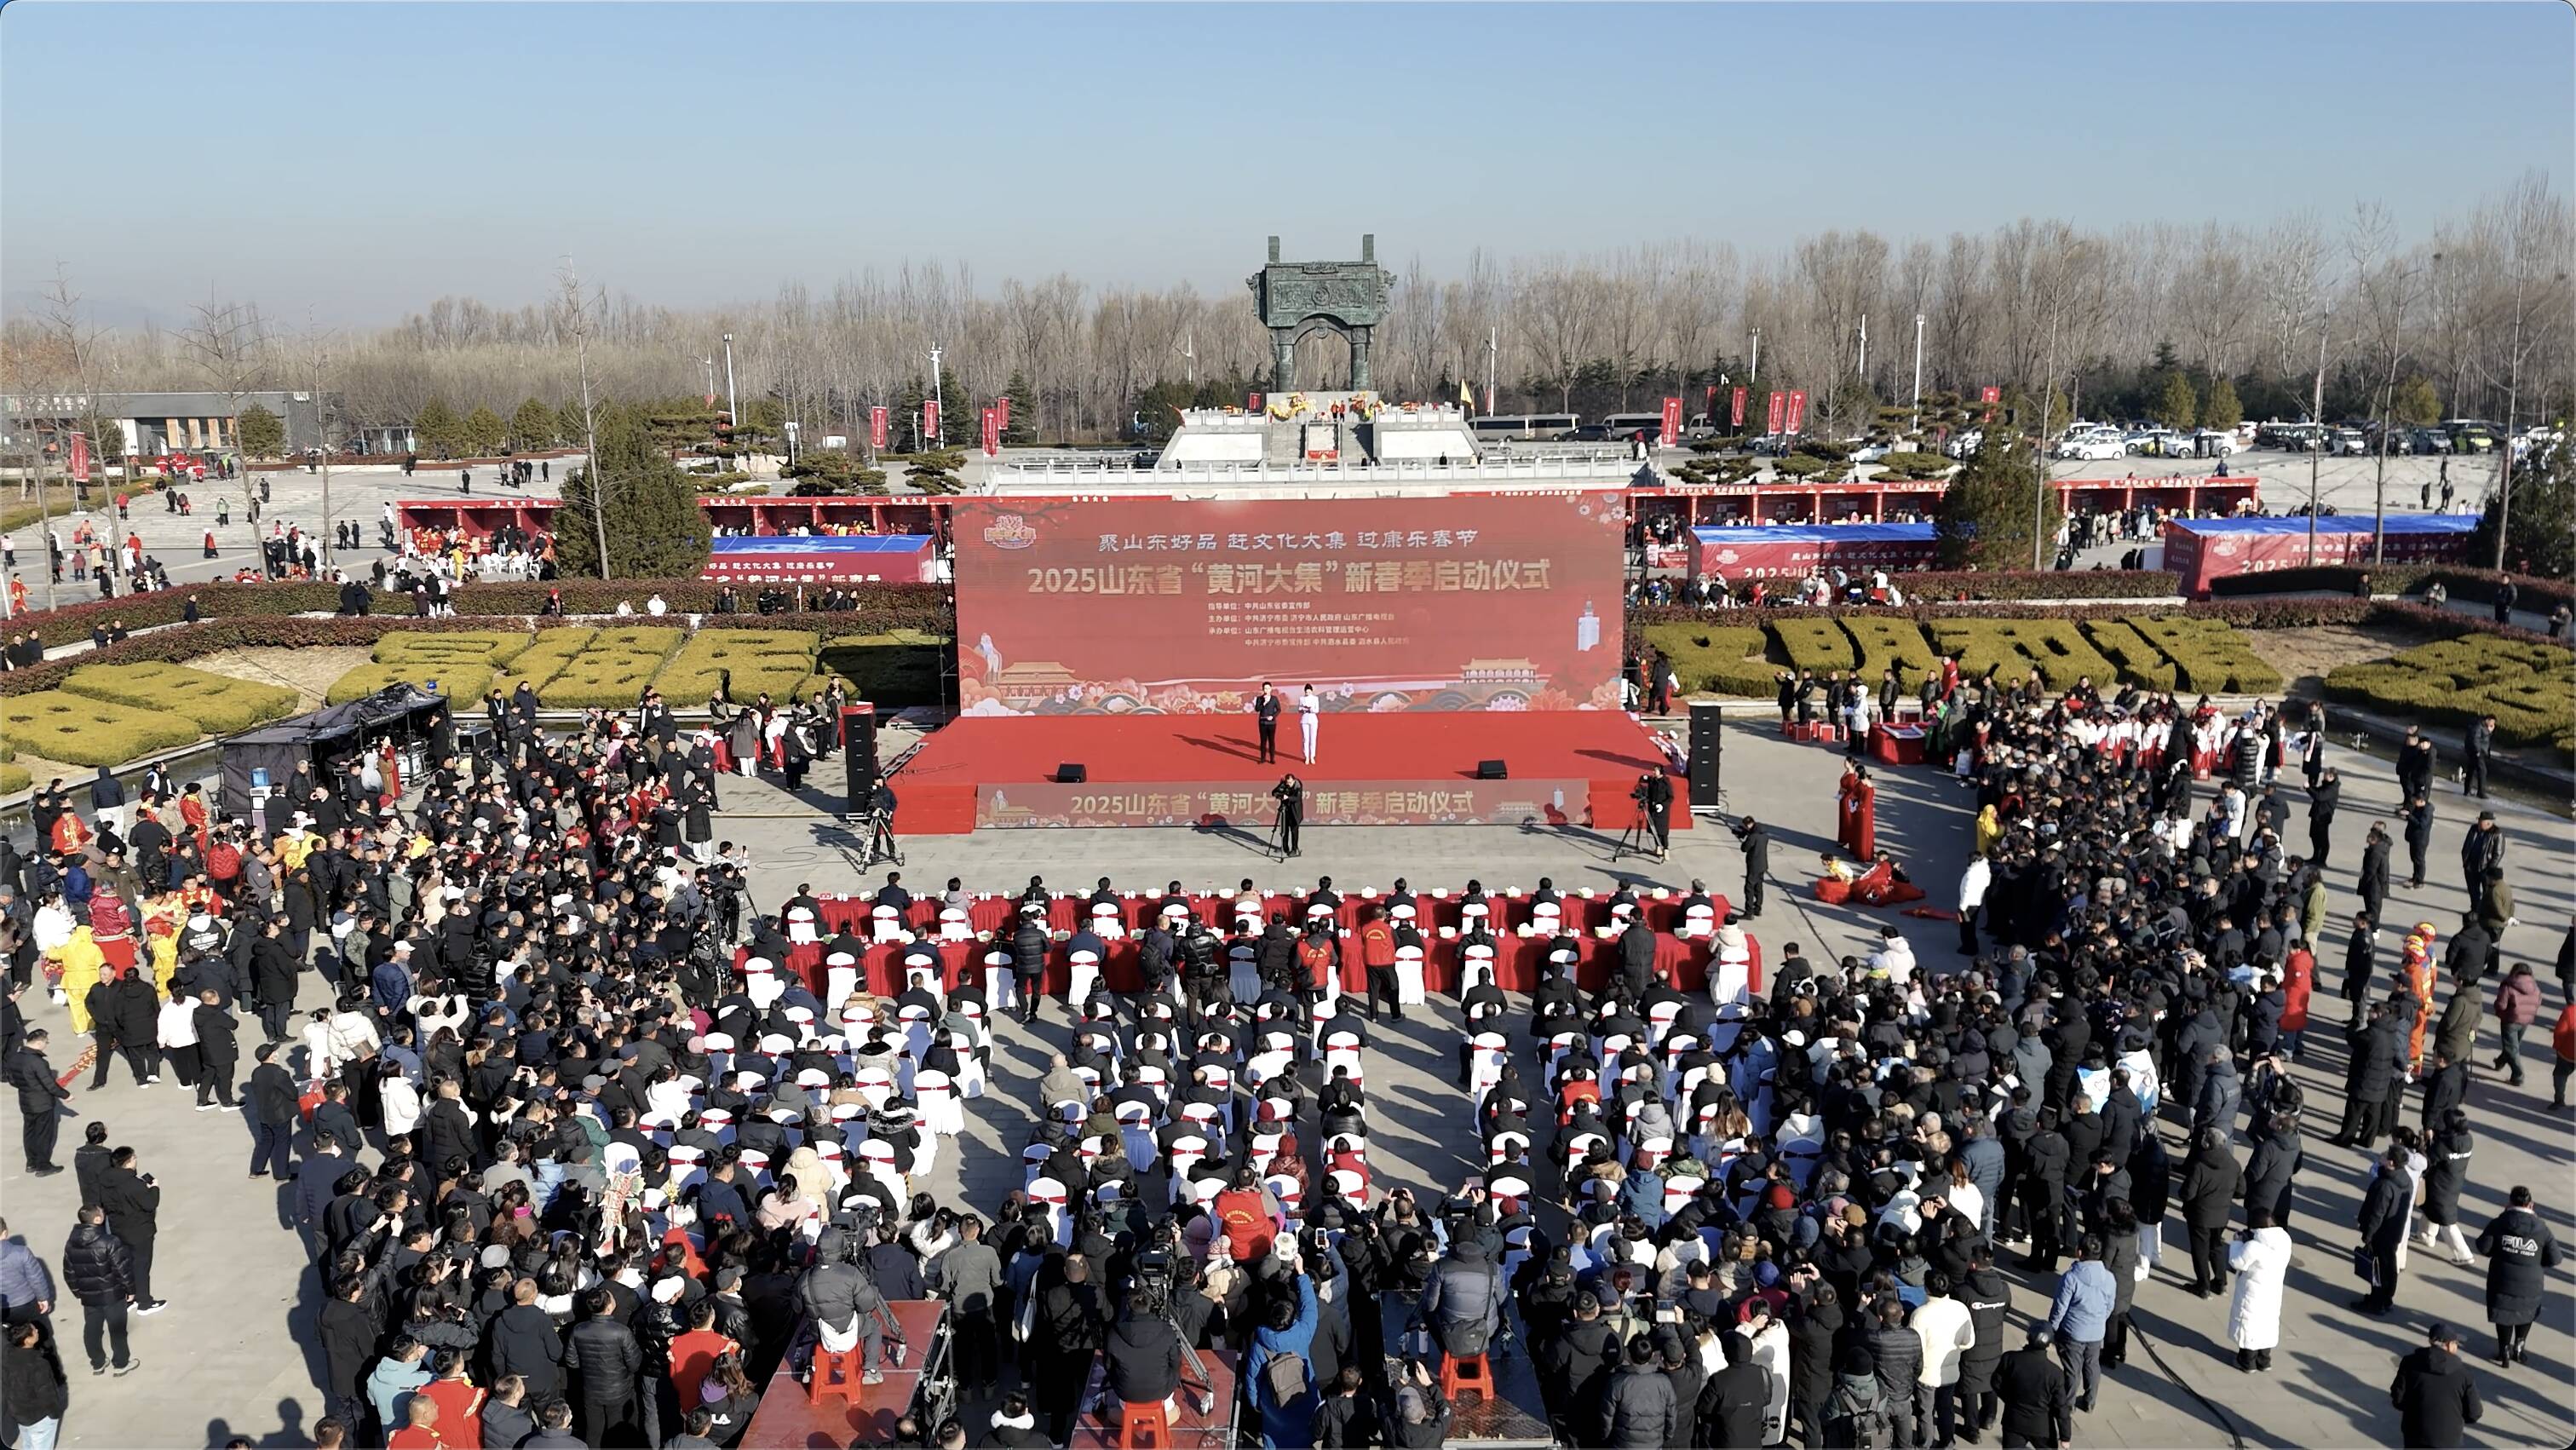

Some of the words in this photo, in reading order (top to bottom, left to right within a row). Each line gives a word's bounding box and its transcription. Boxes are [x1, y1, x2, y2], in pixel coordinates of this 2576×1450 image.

[1098, 532, 1216, 552] 聚山东好品
[1227, 531, 1348, 550] 赶文化大集
[1356, 529, 1479, 548] 过康乐春节
[1027, 559, 1551, 596] 2025山东省“黄河大集”新春季启动仪式
[1070, 791, 1474, 816] 2025山东省“黄河大”新春季启动仪式
[2502, 1235, 2538, 1251] FILA
